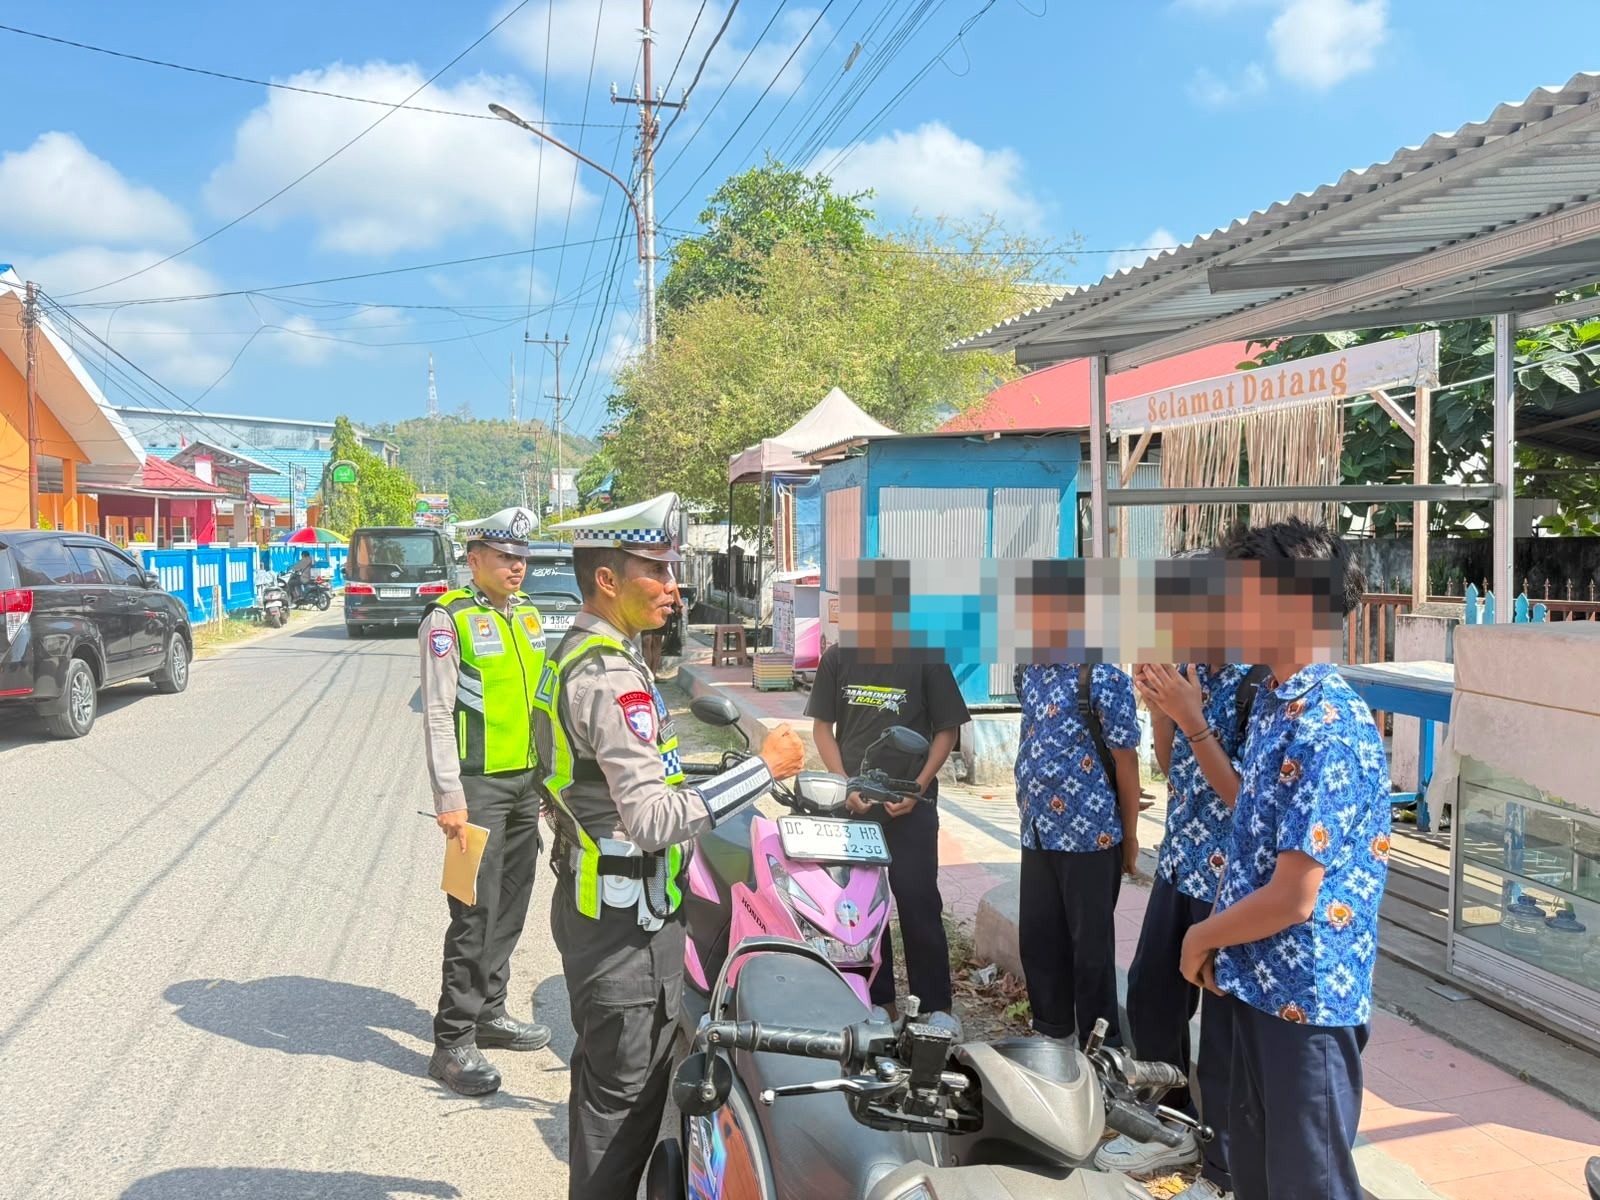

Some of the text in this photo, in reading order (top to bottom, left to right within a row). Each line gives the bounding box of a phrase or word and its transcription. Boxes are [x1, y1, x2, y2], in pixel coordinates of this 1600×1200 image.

[1148, 356, 1347, 423] Selamat Datang
[550, 615, 570, 625] 1304
[855, 696, 885, 705] RACE
[784, 821, 804, 835] DC
[859, 826, 880, 841] HR
[741, 896, 767, 934] HONDA
